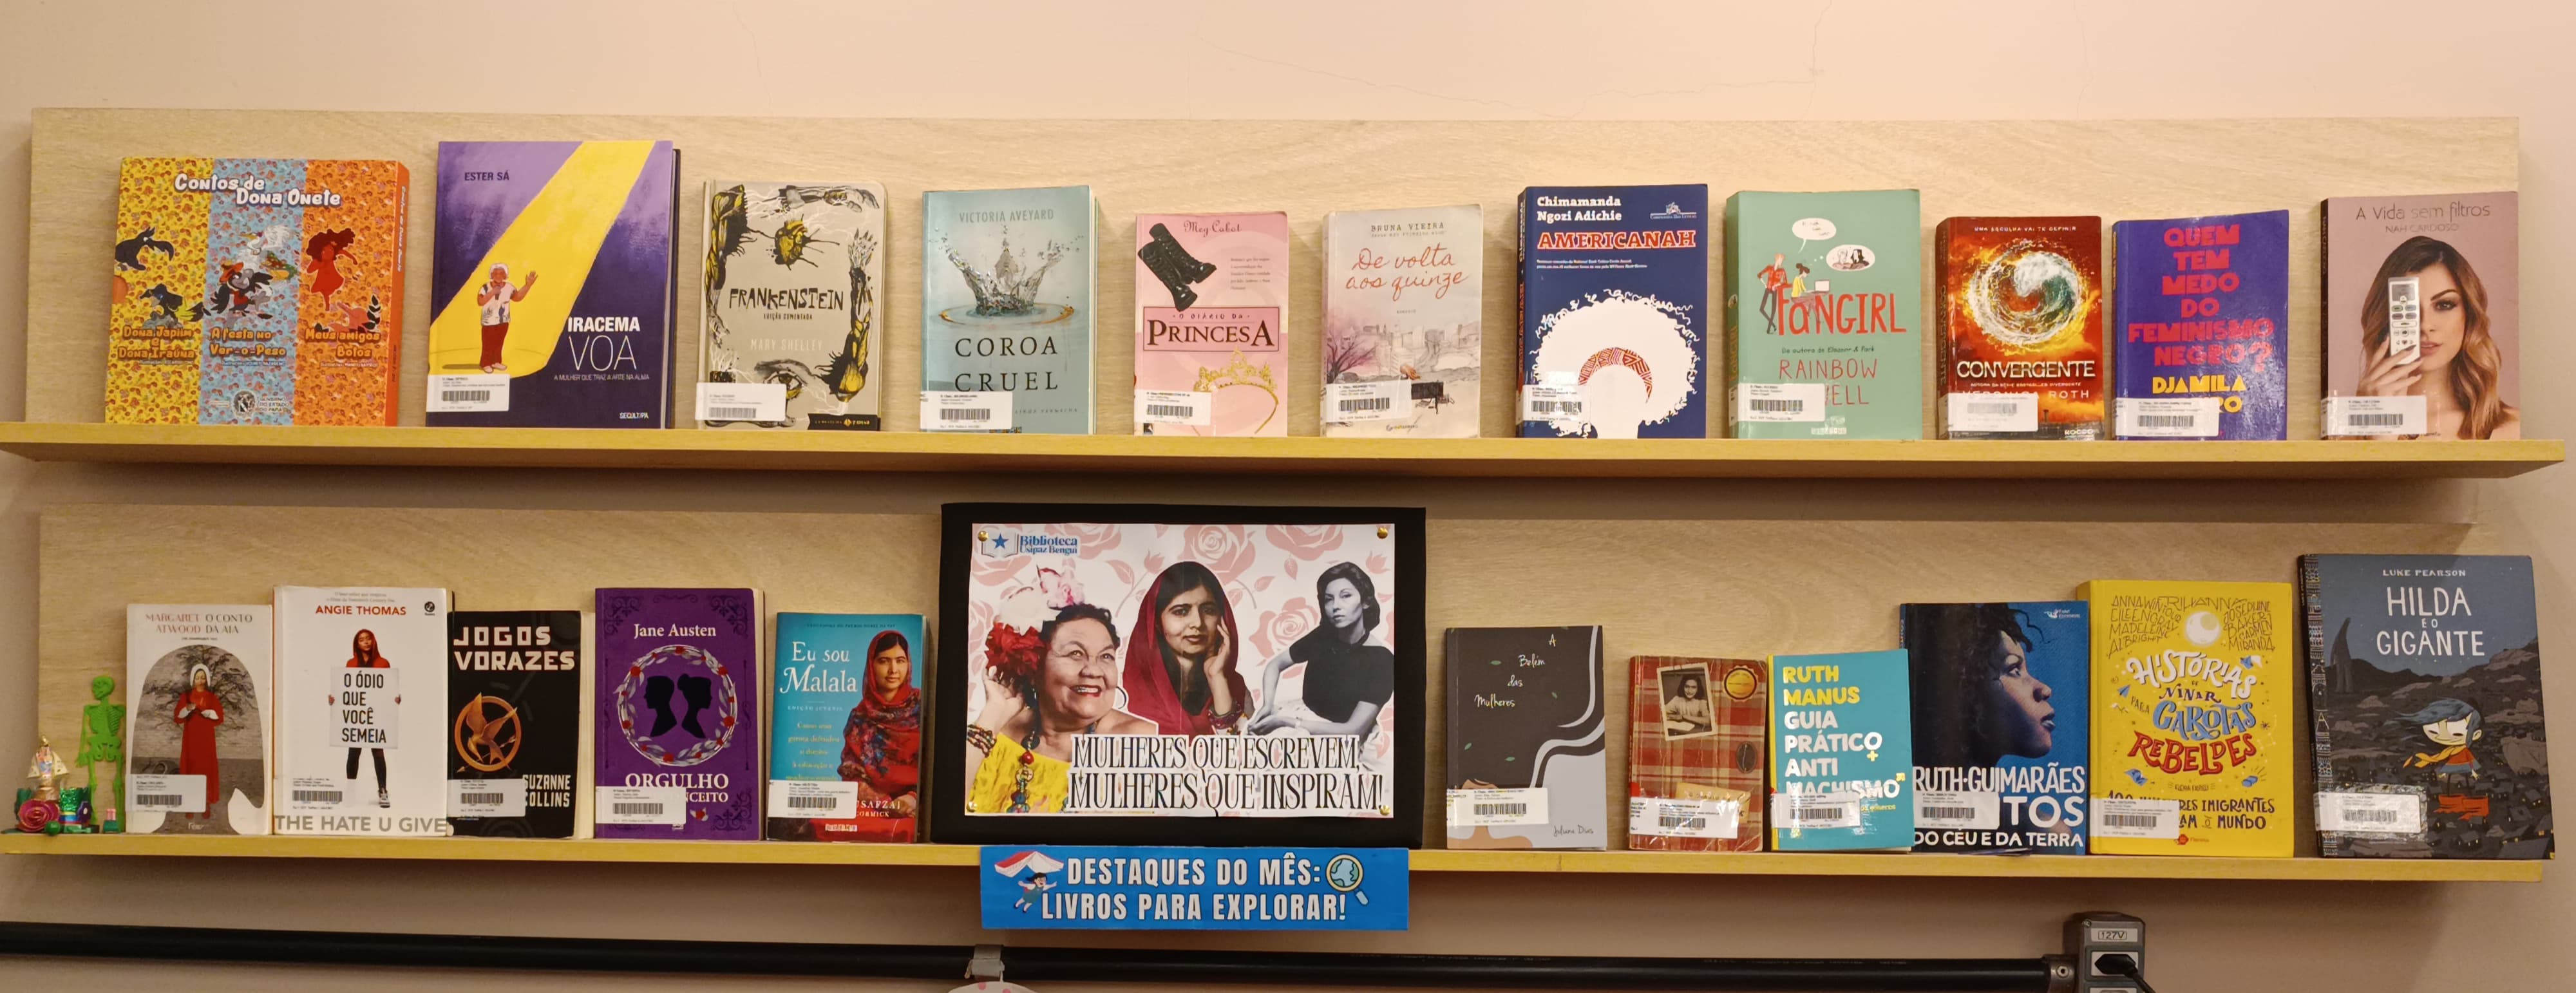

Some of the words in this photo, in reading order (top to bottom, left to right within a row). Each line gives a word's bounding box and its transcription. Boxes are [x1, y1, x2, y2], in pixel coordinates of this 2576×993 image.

[175, 173, 238, 191] Contos
[241, 175, 265, 191] de
[464, 172, 494, 182] ESTER
[496, 170, 509, 181] SÁ
[236, 188, 283, 205] Dona
[288, 189, 341, 207] Onete
[1537, 196, 1622, 207] Chimamanda
[959, 210, 1005, 223] VICTORIA
[1009, 209, 1054, 221] AVEYARD
[1537, 211, 1572, 224] Ngozi
[1575, 210, 1622, 222] Adichie
[2356, 207, 2366, 220] A
[2372, 203, 2405, 220] Vida
[2410, 205, 2444, 219] sem
[2450, 202, 2491, 222] filtros
[1184, 220, 1209, 237] Meg
[1212, 220, 1242, 232] Cabot
[2164, 224, 2240, 247] QUEM
[2385, 225, 2407, 233] NAH
[2409, 223, 2459, 232] CARDOSO
[1537, 230, 1696, 250] AMERICANAH
[1352, 247, 1390, 270] De
[1395, 242, 1456, 269] volta
[2174, 249, 2230, 271] TEM
[1346, 276, 1387, 290] aos
[1391, 270, 1469, 302] quinze
[2162, 272, 2240, 295] MEDO
[729, 288, 843, 310] FRANKENSTEIN
[2181, 298, 2220, 318] DO
[123, 326, 154, 338] Dona
[211, 326, 220, 339] A
[256, 330, 272, 340] no
[567, 316, 640, 332] IRACEMA
[1147, 320, 1274, 346] PRINCESA
[2128, 318, 2274, 343] FEMINISMO
[151, 337, 160, 347] e
[305, 328, 337, 341] Meus
[338, 329, 381, 345] amigos
[751, 339, 776, 351] MARY
[781, 339, 823, 351] SHELLEY
[118, 346, 149, 359] Dona
[569, 335, 637, 371] VOA
[955, 336, 1057, 357] COROA
[2154, 342, 2273, 373] NEGRO?
[1779, 358, 1877, 380] RAINBOW
[1956, 361, 2096, 379] CONVERGENTE
[955, 371, 1058, 392] CRUEL
[2152, 374, 2246, 394] DJAMILA
[2049, 390, 2089, 399] ROTH
[1020, 536, 1077, 545] Biblioteca
[1020, 546, 1047, 554] Usipaz
[2415, 569, 2466, 577] PEARSON
[316, 605, 352, 614] ANGIE
[356, 606, 406, 616] THOMAS
[2111, 595, 2144, 609] ANNA
[2158, 596, 2248, 612] RIHANNA
[2387, 587, 2471, 616] HILDA
[146, 613, 199, 622] MARGARET
[205, 614, 213, 623] O
[216, 614, 252, 623] CONTO
[2421, 618, 2427, 629] E
[2431, 618, 2438, 629] O
[156, 625, 201, 634] ATWOOD
[205, 625, 219, 634] DA
[223, 625, 239, 634] AIA
[453, 626, 551, 647] JOGOS
[634, 623, 664, 639] Jane
[668, 624, 717, 637] Austen
[1548, 634, 1557, 647] A
[2108, 634, 2161, 659] ALBRIGHT
[2229, 636, 2275, 652] MIRANDA
[2376, 630, 2485, 656] GIGANTE
[454, 650, 575, 671] VORAZES
[792, 641, 816, 662] Eu
[823, 649, 850, 662] sou
[1519, 654, 1545, 667] Belém
[344, 673, 352, 688] O
[356, 670, 384, 688] ÓDIO
[780, 665, 858, 694] Malala
[1508, 674, 1523, 687] das
[1783, 666, 1839, 683] RUTH
[2126, 649, 2257, 699] HISTÓRIAS
[343, 691, 366, 706] QUE
[1474, 694, 1515, 708] Mulheres
[1783, 686, 1860, 706] MANUS
[2159, 683, 2221, 703] NINAR
[2131, 695, 2150, 714] PARA
[343, 707, 374, 725] VOCÊ
[1784, 711, 1838, 729] GUIA
[2153, 701, 2257, 741] GAROTAS
[342, 728, 387, 743] SEMEIA
[1785, 728, 1882, 753] PRÁTICO
[1074, 736, 1188, 768] MULHERES
[1193, 737, 1237, 781] QUE
[1243, 736, 1360, 772] ESCREVEM,
[2128, 731, 2257, 775] REBELDES
[1785, 758, 1838, 777] ANTI
[522, 774, 571, 790] SUZANNE
[625, 773, 729, 789] ORGULHO
[1913, 766, 1962, 792] RUTH
[1968, 762, 2085, 793] GUIMARÃES
[1070, 773, 1198, 809] MULHERES
[1205, 773, 1255, 817] QUE
[1262, 774, 1384, 809] INSPIRAM!
[1786, 779, 1900, 799] MACHISMO
[2201, 797, 2275, 813] IMIGRANTES
[274, 815, 313, 830] THE
[321, 816, 371, 831] HATE
[379, 817, 392, 832] U
[399, 817, 447, 833] GIVE
[2217, 815, 2266, 829] MUNDO
[1914, 831, 1939, 846] DO
[1943, 828, 1977, 846] CÉU
[1982, 831, 1991, 846] E
[1996, 832, 2023, 846] DA
[2028, 832, 2083, 847] TERRA
[1067, 858, 1206, 887] DESTAQUES
[1217, 858, 1248, 886] DO
[1258, 852, 1321, 886] MÊS:
[1041, 893, 1128, 921] LIVROS
[1139, 893, 1202, 921] PARA
[1213, 893, 1346, 921] EXPLORAR!
